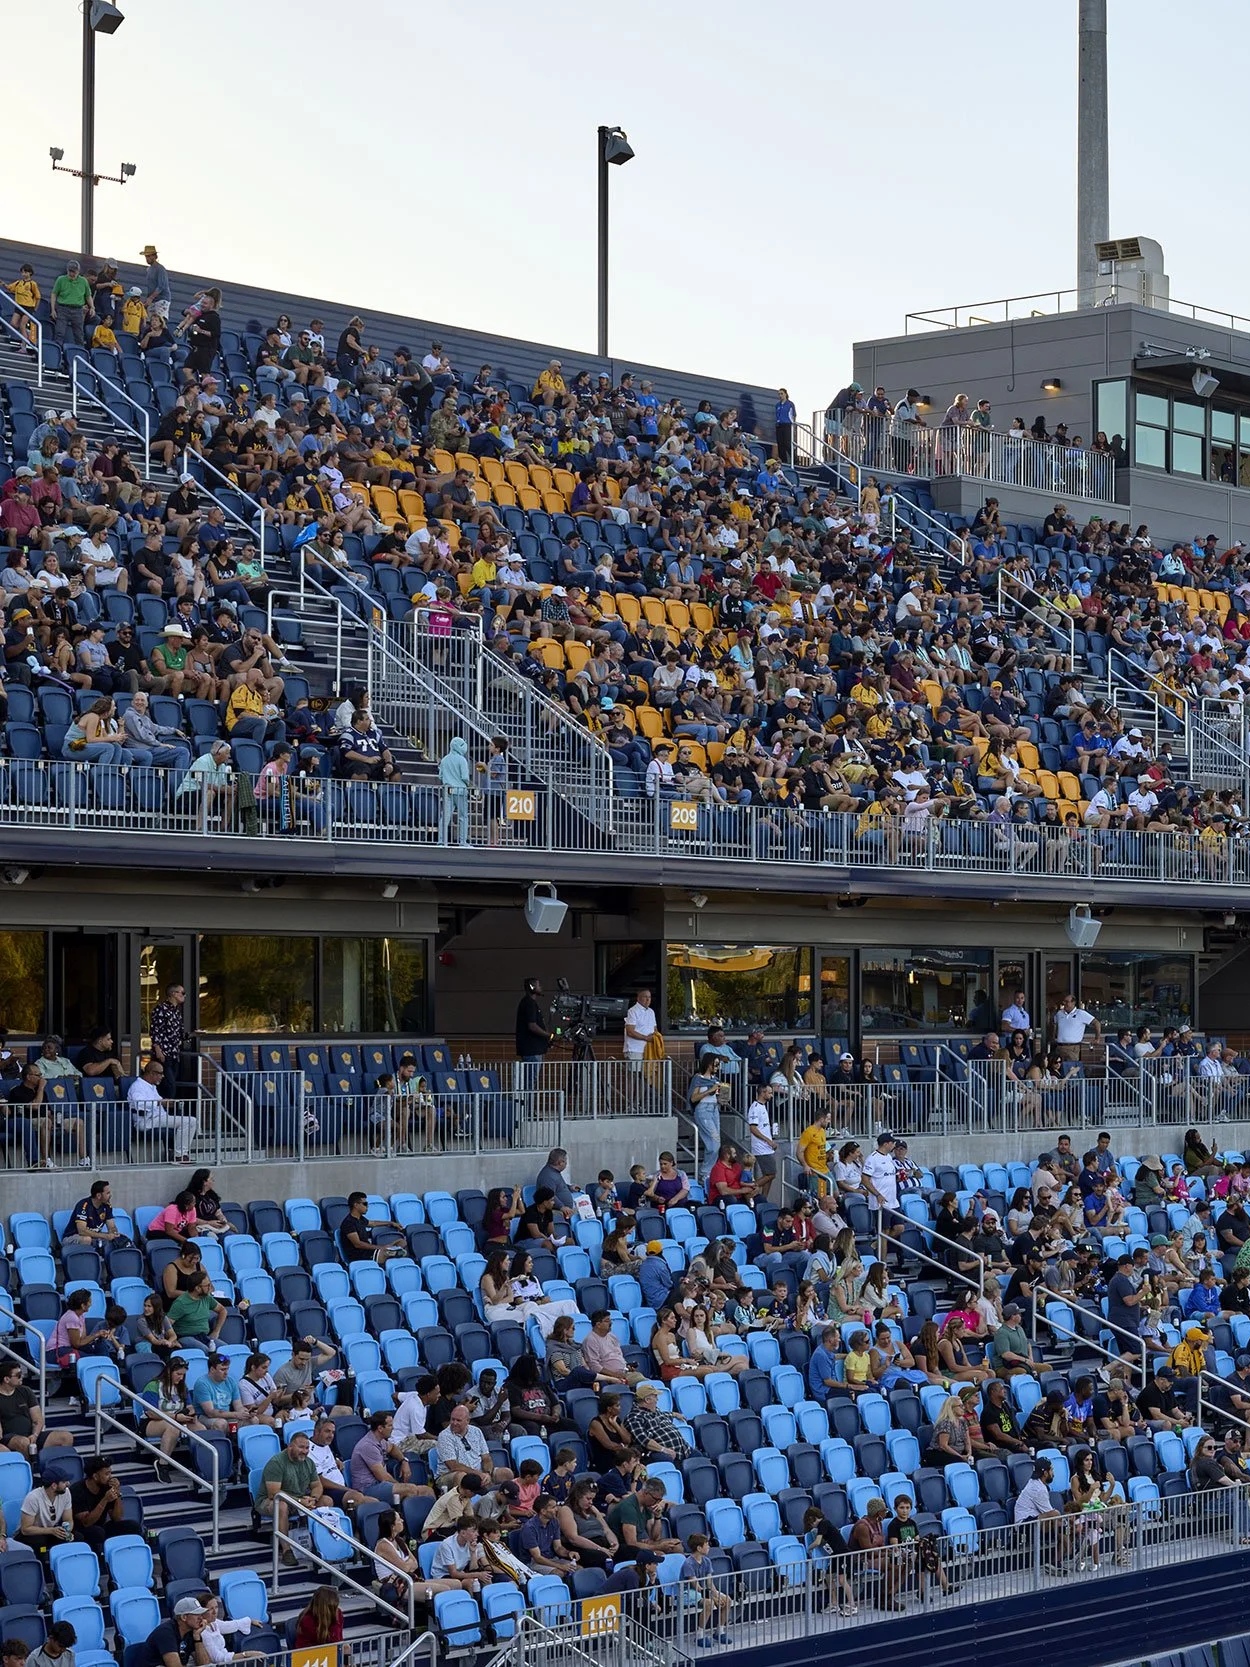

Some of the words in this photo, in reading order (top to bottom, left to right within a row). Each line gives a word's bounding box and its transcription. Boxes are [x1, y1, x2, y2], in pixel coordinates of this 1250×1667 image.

[508, 798, 533, 814] 210
[671, 808, 697, 824] 209
[587, 1604, 617, 1631] 110
